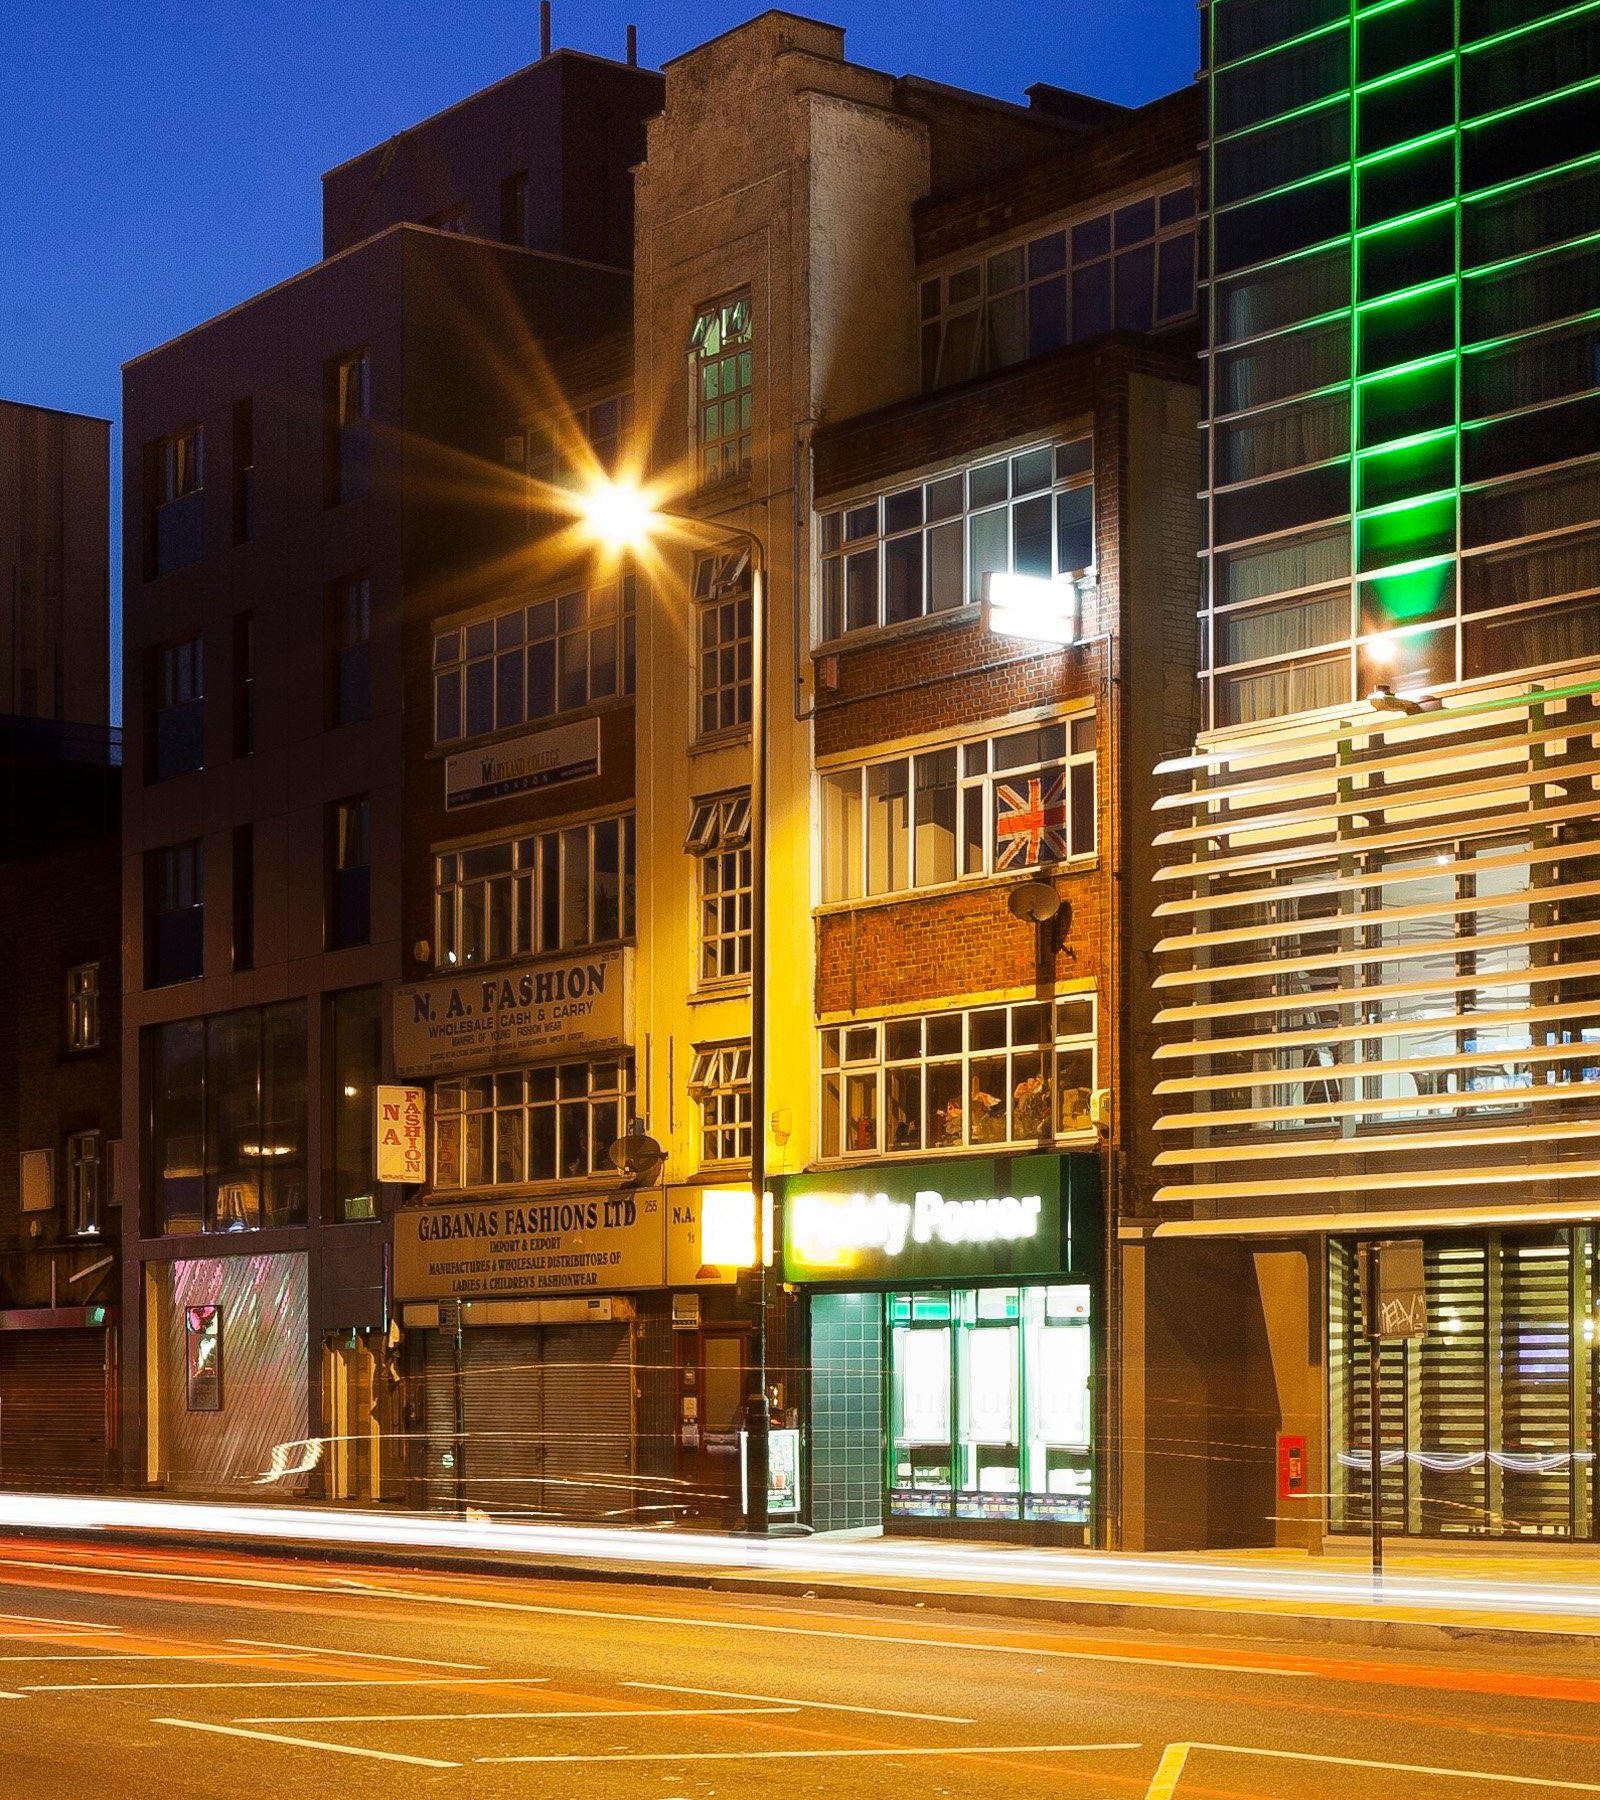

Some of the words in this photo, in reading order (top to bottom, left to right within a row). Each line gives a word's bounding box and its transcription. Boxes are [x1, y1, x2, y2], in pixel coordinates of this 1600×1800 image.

[481, 963, 606, 1014] FASHION
[428, 1017, 494, 1038] WHOLESALE
[500, 1011, 531, 1027] CASH
[538, 1008, 545, 1021] &
[553, 1001, 593, 1019] CARRY
[404, 1091, 422, 1173] FASHION
[419, 1211, 499, 1241] GABANAS
[504, 1202, 598, 1235] FASHIONS
[603, 1199, 637, 1228] LTD
[913, 1190, 1042, 1244] Power
[428, 1260, 490, 1276] MANUFACTURES
[498, 1255, 547, 1272] WHOLESALE
[547, 1253, 608, 1269] DISTRIBUTORS
[609, 1252, 622, 1265] OF
[489, 1240, 520, 1253] IMPORT
[522, 1239, 528, 1252] &
[530, 1237, 561, 1250] EXPORT
[451, 1279, 481, 1292] LADIES
[537, 1272, 598, 1289] FASHIONWEAR
